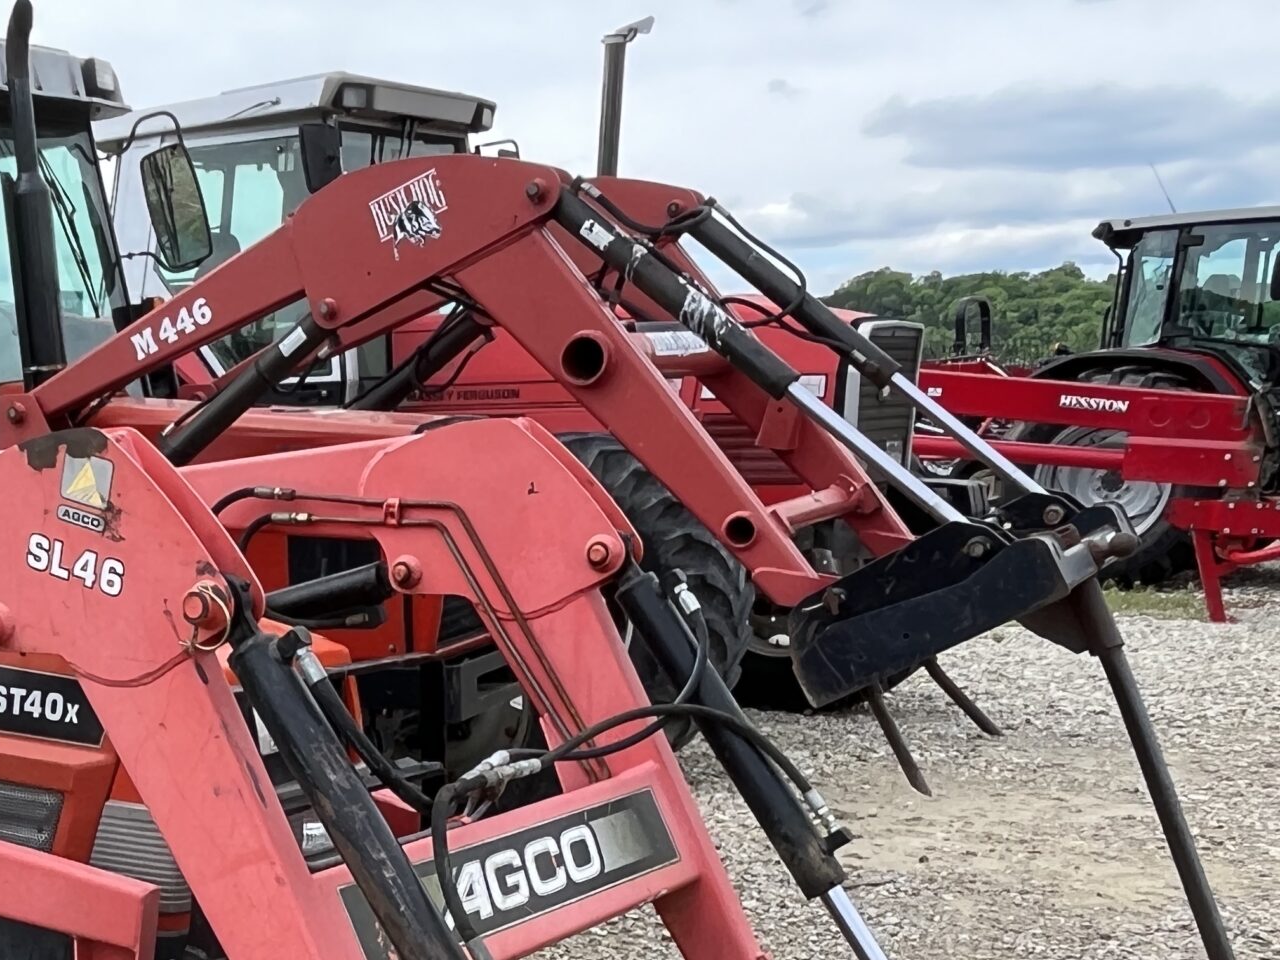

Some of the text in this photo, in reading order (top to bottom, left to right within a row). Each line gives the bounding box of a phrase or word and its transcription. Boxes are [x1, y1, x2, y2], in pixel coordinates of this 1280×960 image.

[130, 297, 212, 361] M 446
[457, 388, 520, 400] FERGUSON
[1059, 394, 1129, 412] HESSTON
[60, 508, 101, 530] AGCO
[26, 533, 125, 596] SL46
[445, 824, 601, 929] AGCO
